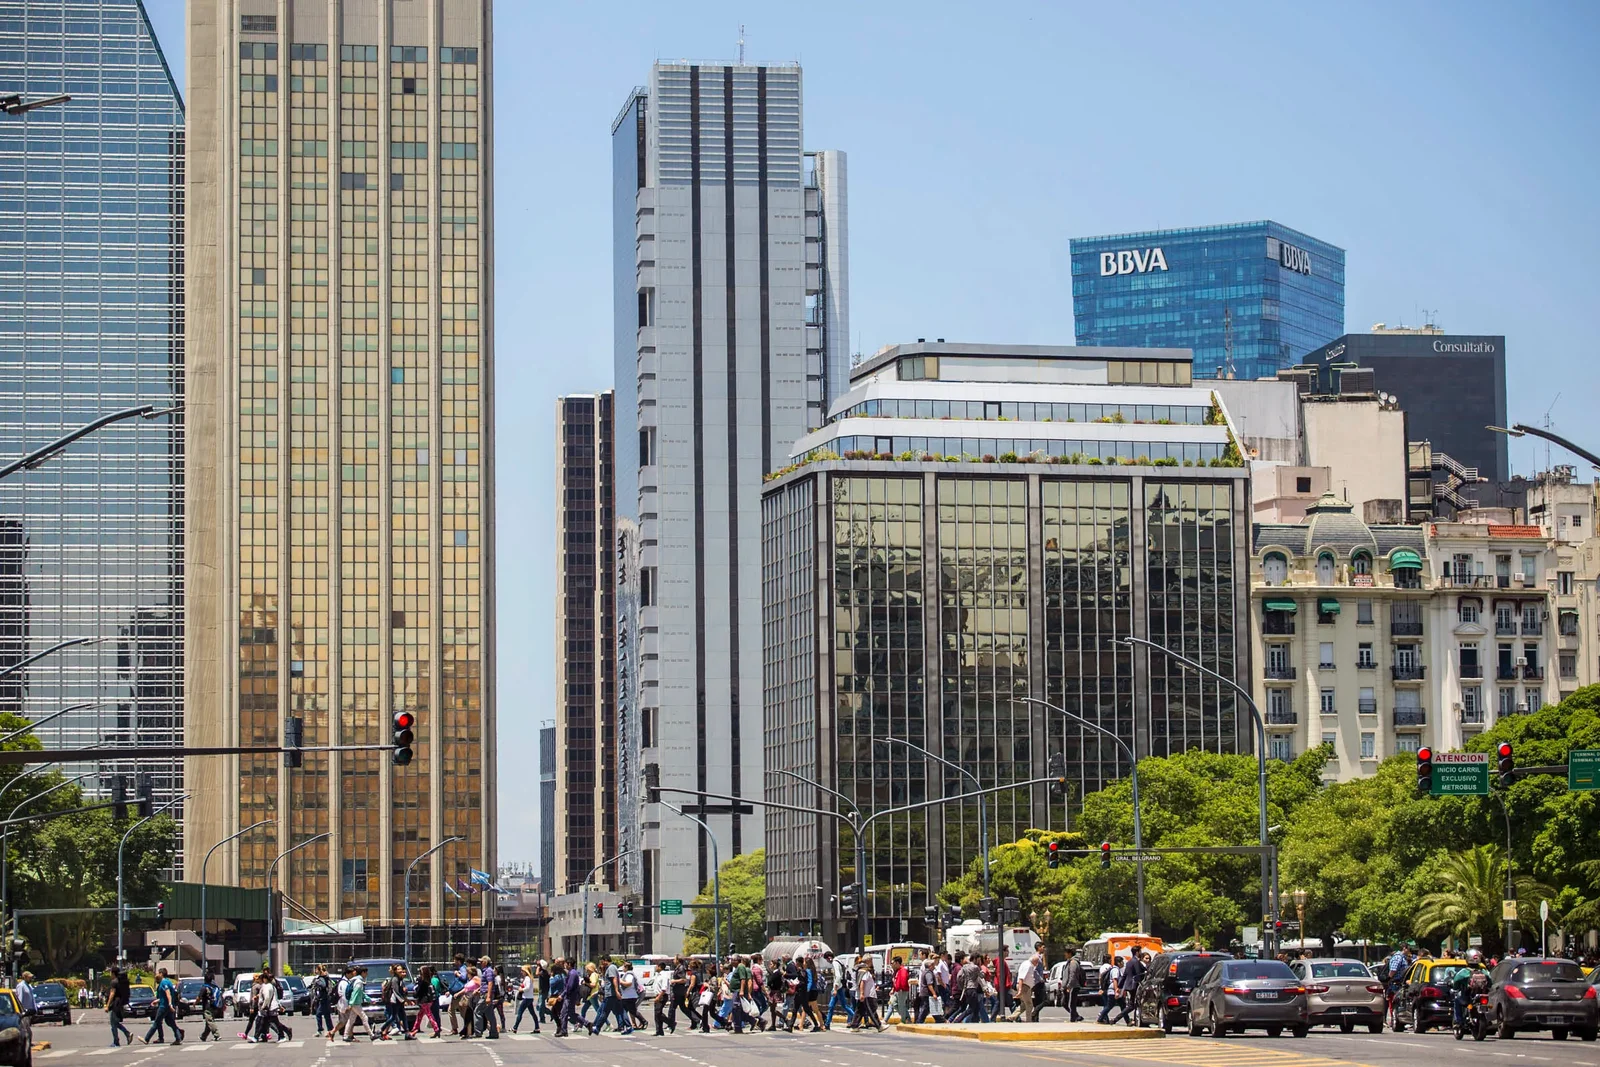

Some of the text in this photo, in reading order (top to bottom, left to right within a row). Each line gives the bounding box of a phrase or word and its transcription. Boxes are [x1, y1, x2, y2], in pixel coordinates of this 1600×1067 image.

[1100, 247, 1169, 277] BBVA
[1283, 244, 1312, 275] BBVA
[1433, 340, 1495, 353] Consultatio
[1435, 754, 1484, 763] ATENCION
